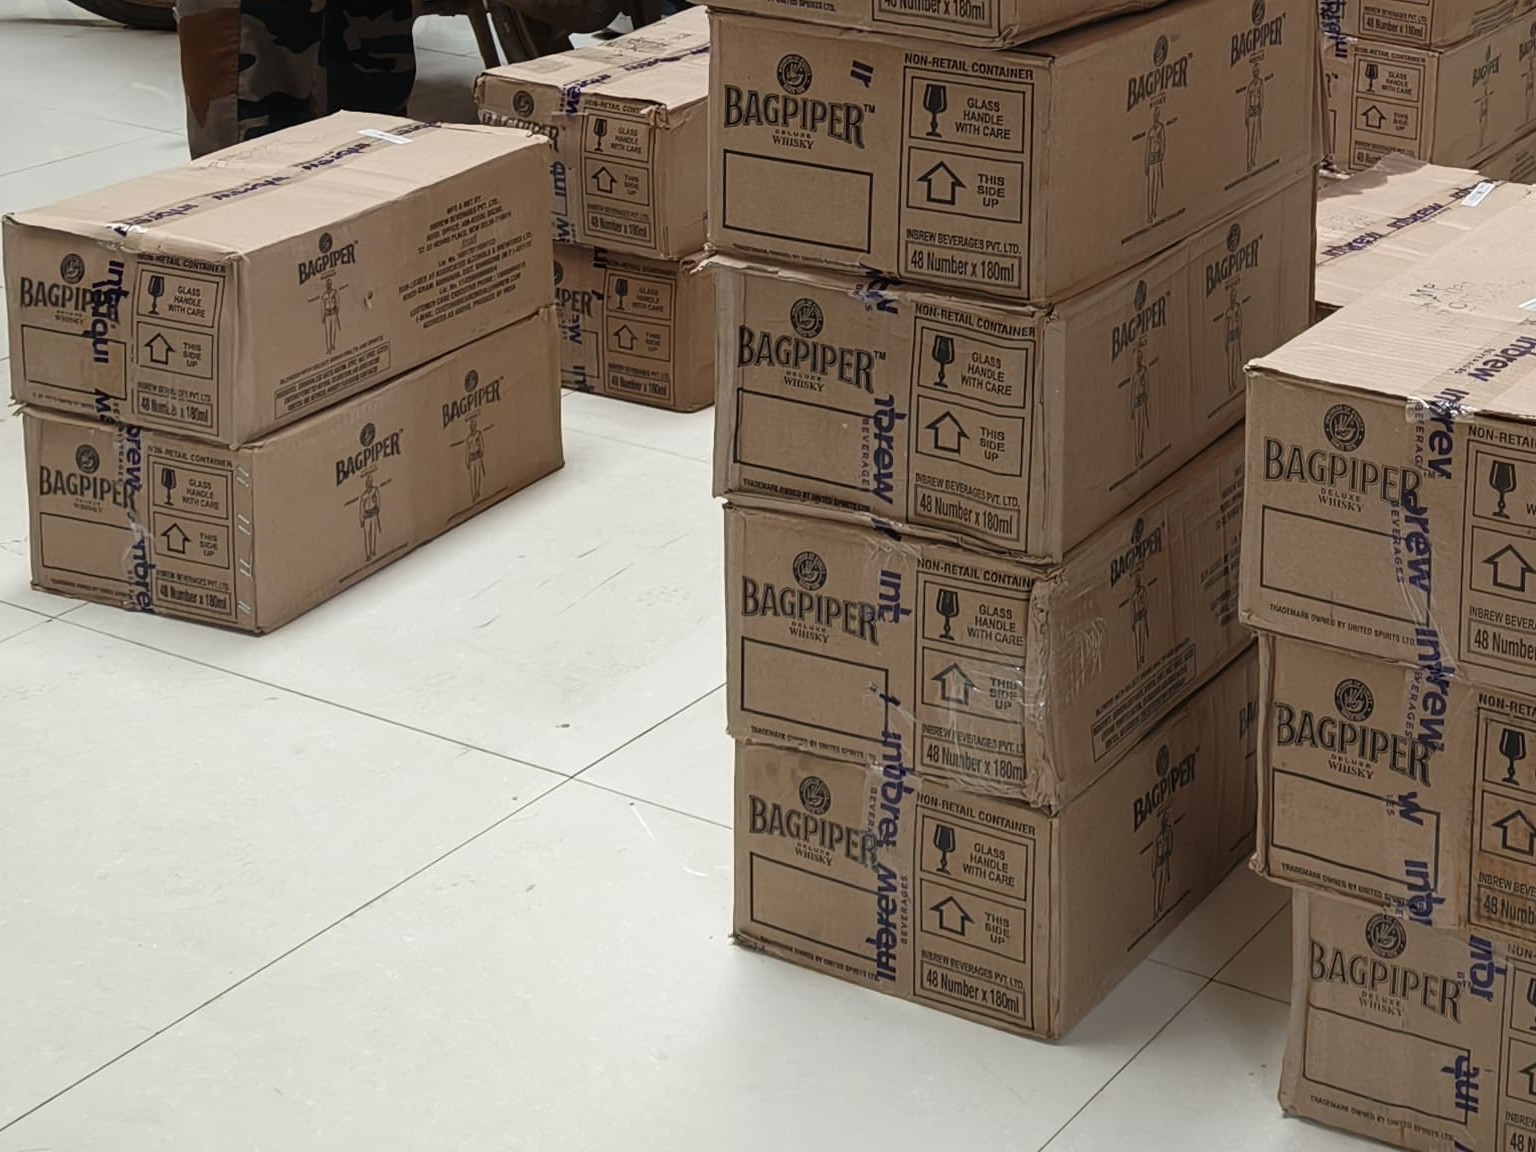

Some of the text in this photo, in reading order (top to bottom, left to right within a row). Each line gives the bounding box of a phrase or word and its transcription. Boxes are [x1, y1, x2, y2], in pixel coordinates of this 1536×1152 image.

[1230, 15, 1283, 67] BAGPIPER
[904, 53, 1033, 80] NON-RETAIL CONTAINER
[1126, 55, 1189, 112] BAGPIPER
[967, 97, 1000, 112] GLASS
[724, 84, 865, 149] BAGPIPER
[963, 109, 1004, 126] HANDLE
[772, 134, 815, 150] WHISKY
[955, 121, 1011, 140] WITH CARE
[977, 173, 1005, 186] THIS
[977, 182, 1005, 198] SIDE
[983, 197, 999, 207] UP
[938, 233, 988, 251] BEVERAGES
[298, 243, 356, 286] BAGPIPER
[911, 249, 924, 269] 48
[927, 251, 969, 275] Number
[981, 260, 1014, 282] 180ml
[1205, 239, 1259, 298] BAGPIPER
[915, 301, 1035, 338] NON-RETAIL CONTAINER
[1111, 294, 1166, 363] BAGPIPER
[737, 324, 875, 394] BAGPIPER
[971, 352, 1001, 367] GLASS
[967, 362, 1005, 381] HANDLE
[961, 373, 1012, 396] WITH CARE
[441, 383, 501, 428] BAGPIPER
[979, 434, 1005, 452] SIDE
[984, 448, 999, 459] UP
[335, 434, 402, 488] BAGPIPER
[1264, 436, 1423, 512] BAGPIPER
[39, 465, 136, 512] BAGPIPER
[1321, 487, 1362, 502] DELUXE
[920, 493, 1013, 535] 48 Number 180ml
[1318, 494, 1364, 513] WHISKY
[916, 557, 981, 580] NON-RETAIL
[741, 575, 879, 646] BAGPIPER
[978, 603, 1014, 620] GLASS
[1469, 605, 1504, 623] INBREW
[974, 615, 1017, 633] HANDLE
[966, 627, 1024, 647] WITH CARE
[1474, 628, 1489, 650] 48
[1274, 701, 1432, 788] BAGPIPER
[1328, 759, 1374, 780] WHISKY
[1133, 751, 1197, 833] BAGPIPER
[978, 810, 1035, 836] CONTAINER
[974, 842, 1005, 860] GLASS
[970, 853, 1008, 874] HANDLE
[963, 863, 1015, 888] WITH CARE
[1483, 893, 1498, 916] 48
[926, 969, 1019, 1013] 48 Number 180ml
[1310, 940, 1462, 1024] BAGPIPER
